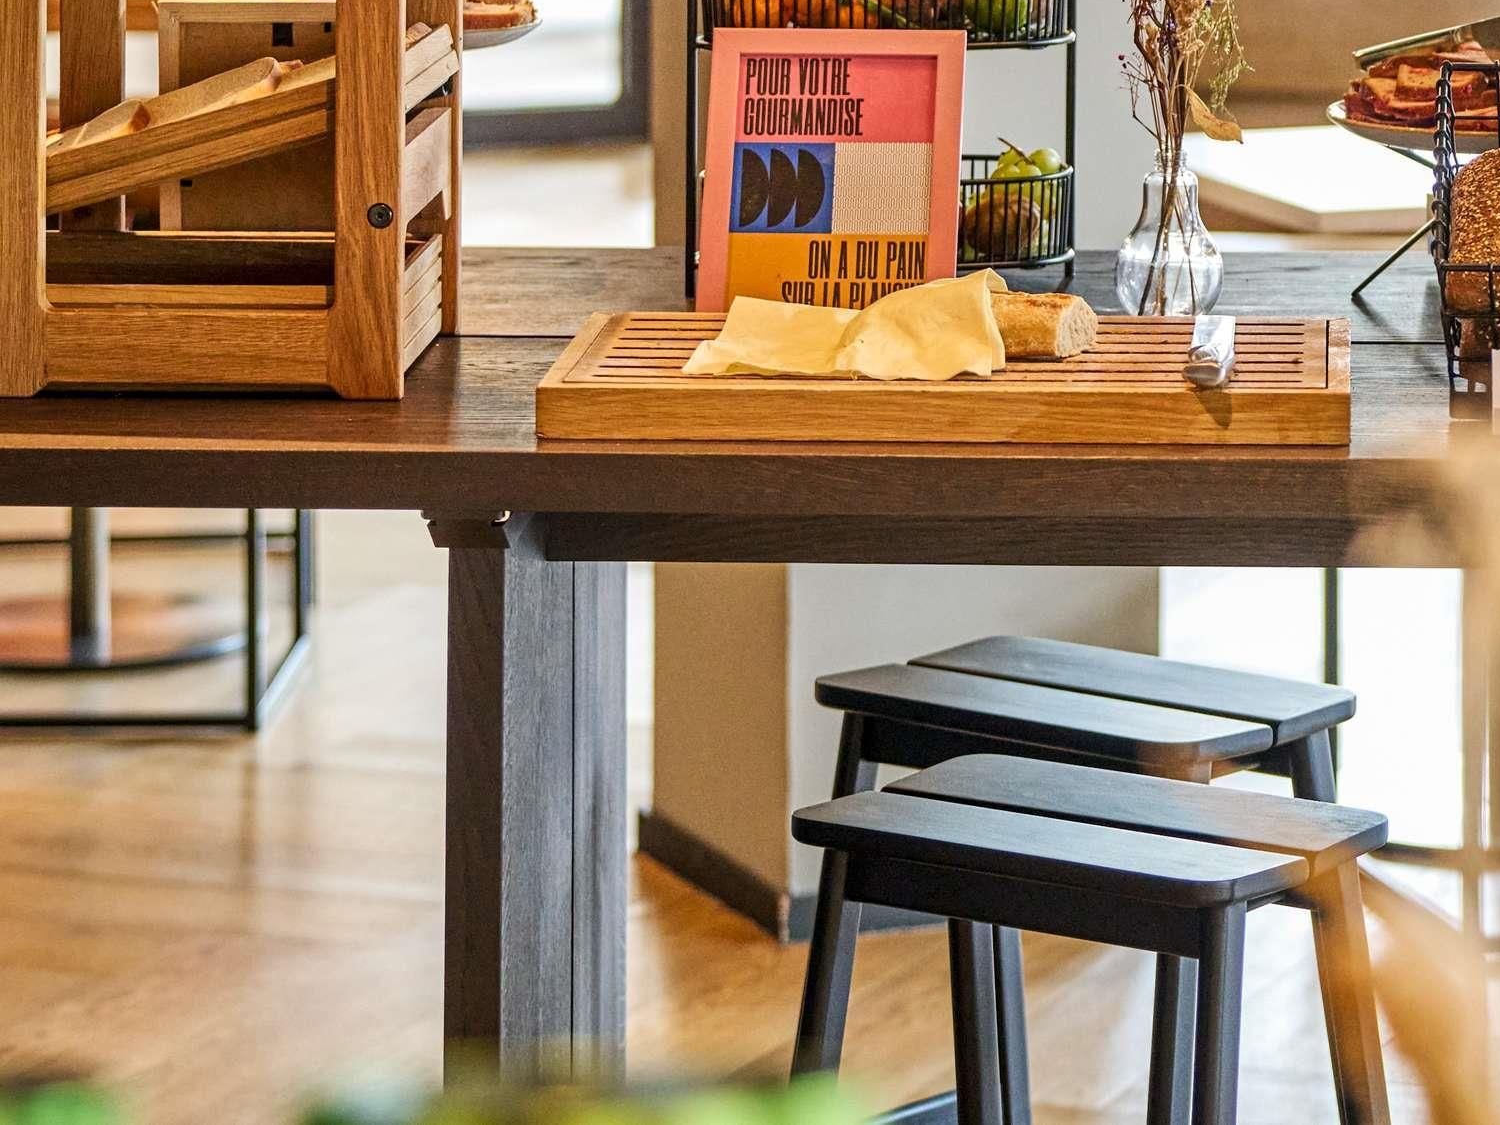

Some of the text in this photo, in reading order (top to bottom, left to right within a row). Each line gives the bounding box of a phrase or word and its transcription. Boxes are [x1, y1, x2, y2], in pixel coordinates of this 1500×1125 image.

[745, 57, 852, 96] POUR VOTRE
[743, 97, 865, 137] GOURMANDISE
[807, 240, 926, 280] ON A DU PAIN
